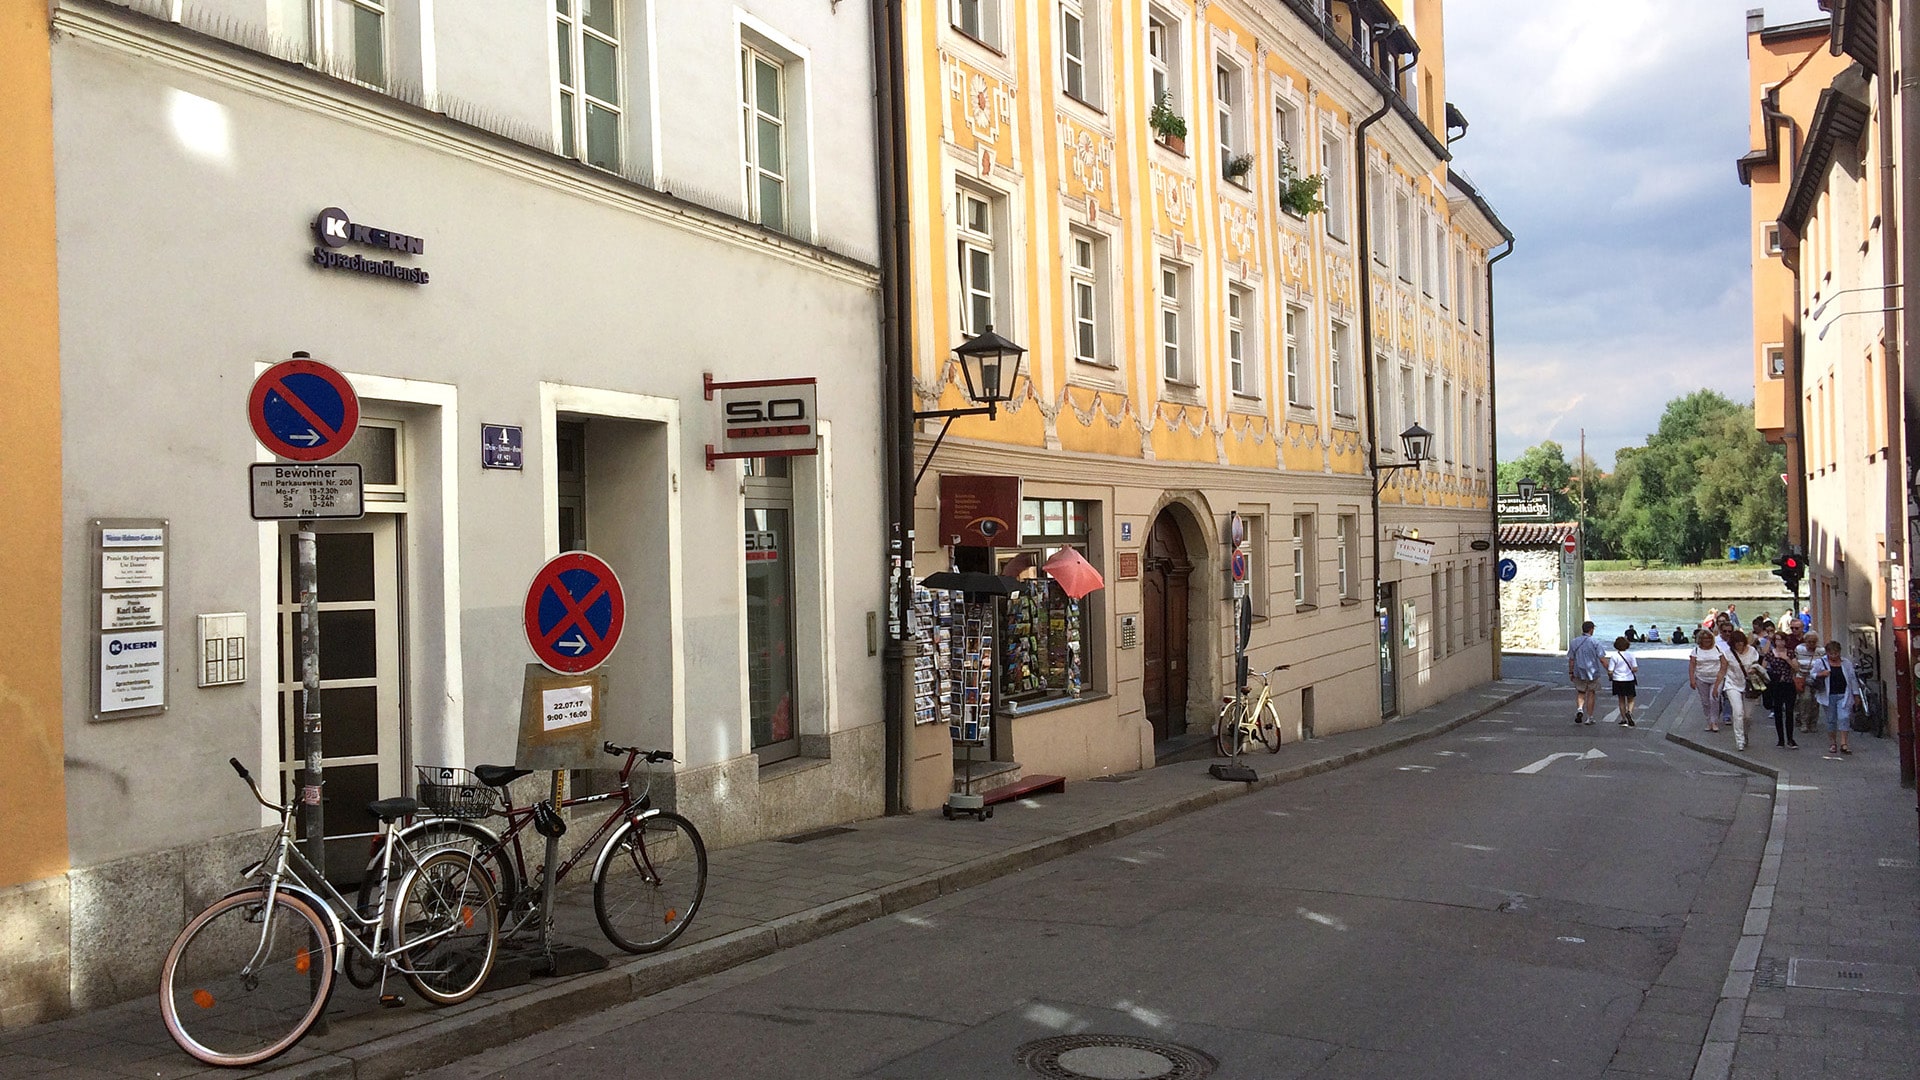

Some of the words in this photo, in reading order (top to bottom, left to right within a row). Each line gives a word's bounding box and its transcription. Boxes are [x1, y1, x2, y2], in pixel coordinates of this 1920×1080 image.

[349, 223, 424, 255] KERN
[313, 246, 430, 285] Sprachendienste
[498, 428, 510, 444] 4
[740, 426, 794, 436] HAARE
[275, 468, 337, 478] Bewohner
[116, 607, 131, 615] Karl
[123, 640, 158, 650] KERN
[553, 700, 584, 710] 22.07.17
[546, 713, 563, 722] 9:00
[569, 710, 588, 719] 16:00
